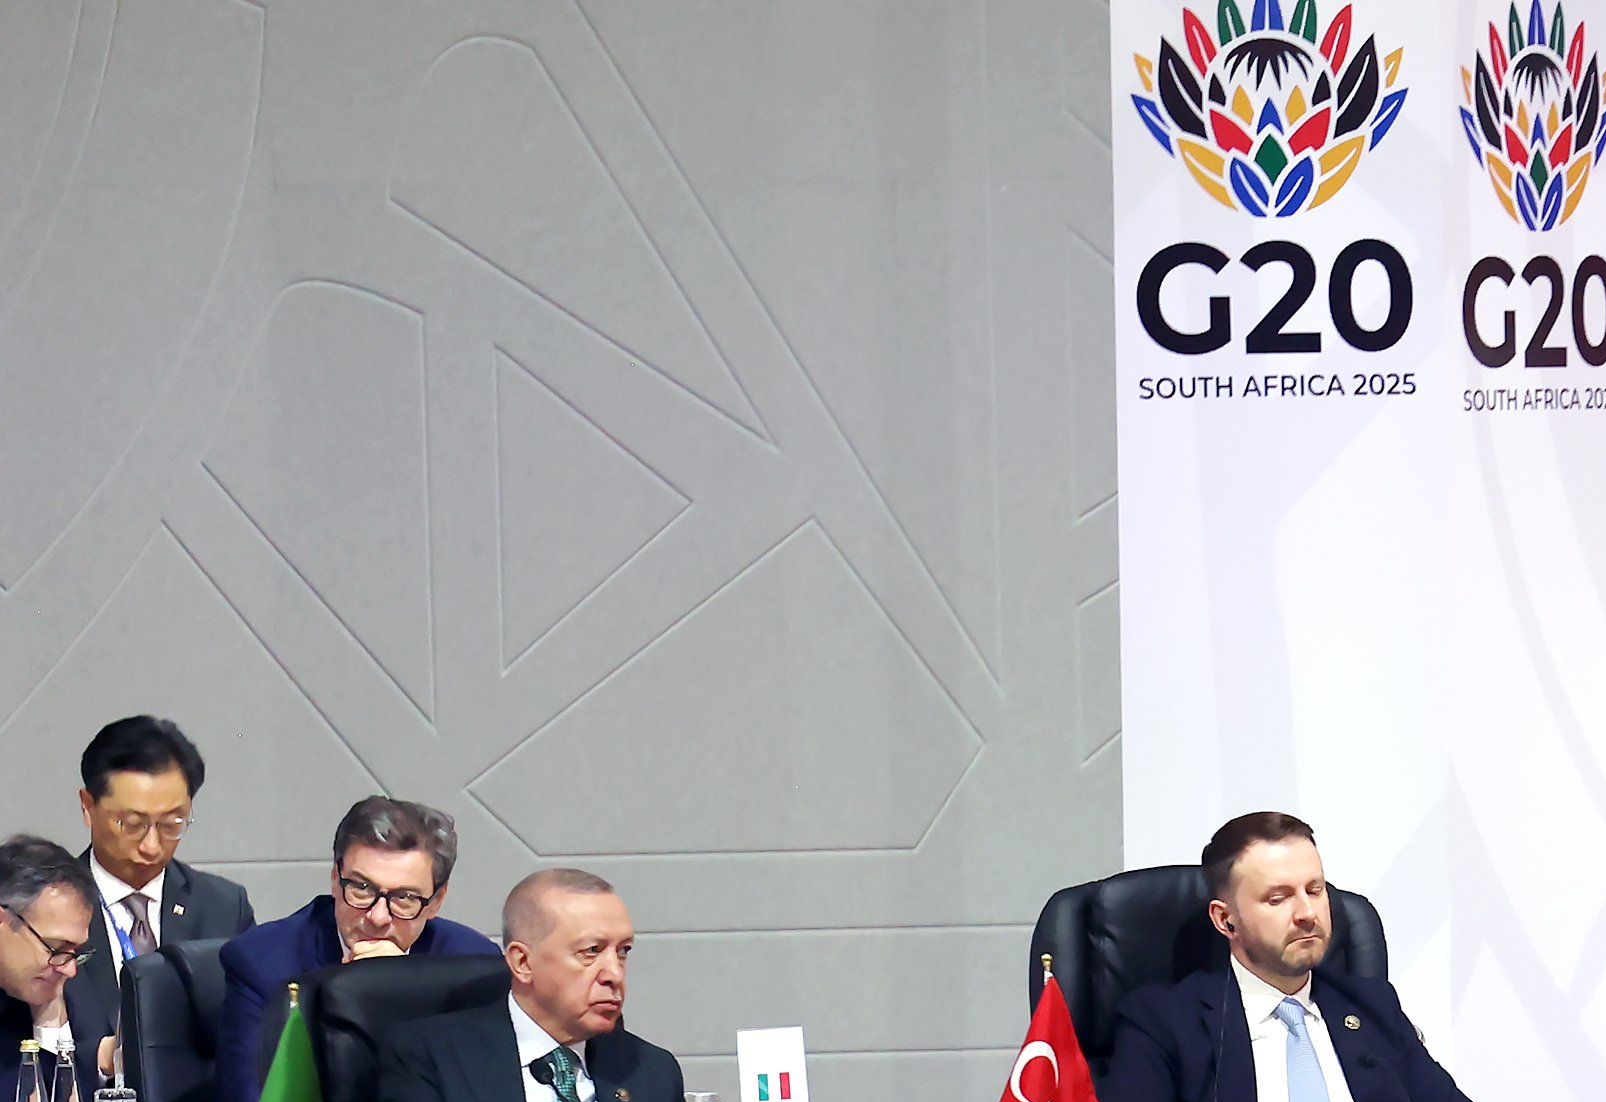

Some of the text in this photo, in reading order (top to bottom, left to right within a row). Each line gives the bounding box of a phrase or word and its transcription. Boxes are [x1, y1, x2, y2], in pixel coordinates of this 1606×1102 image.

[1136, 239, 1414, 355] G20
[1138, 373, 1417, 399] SOUTH AFRICA 2025
[1463, 389, 1518, 412] SOUTH
[1522, 387, 1582, 411] AFRICA
